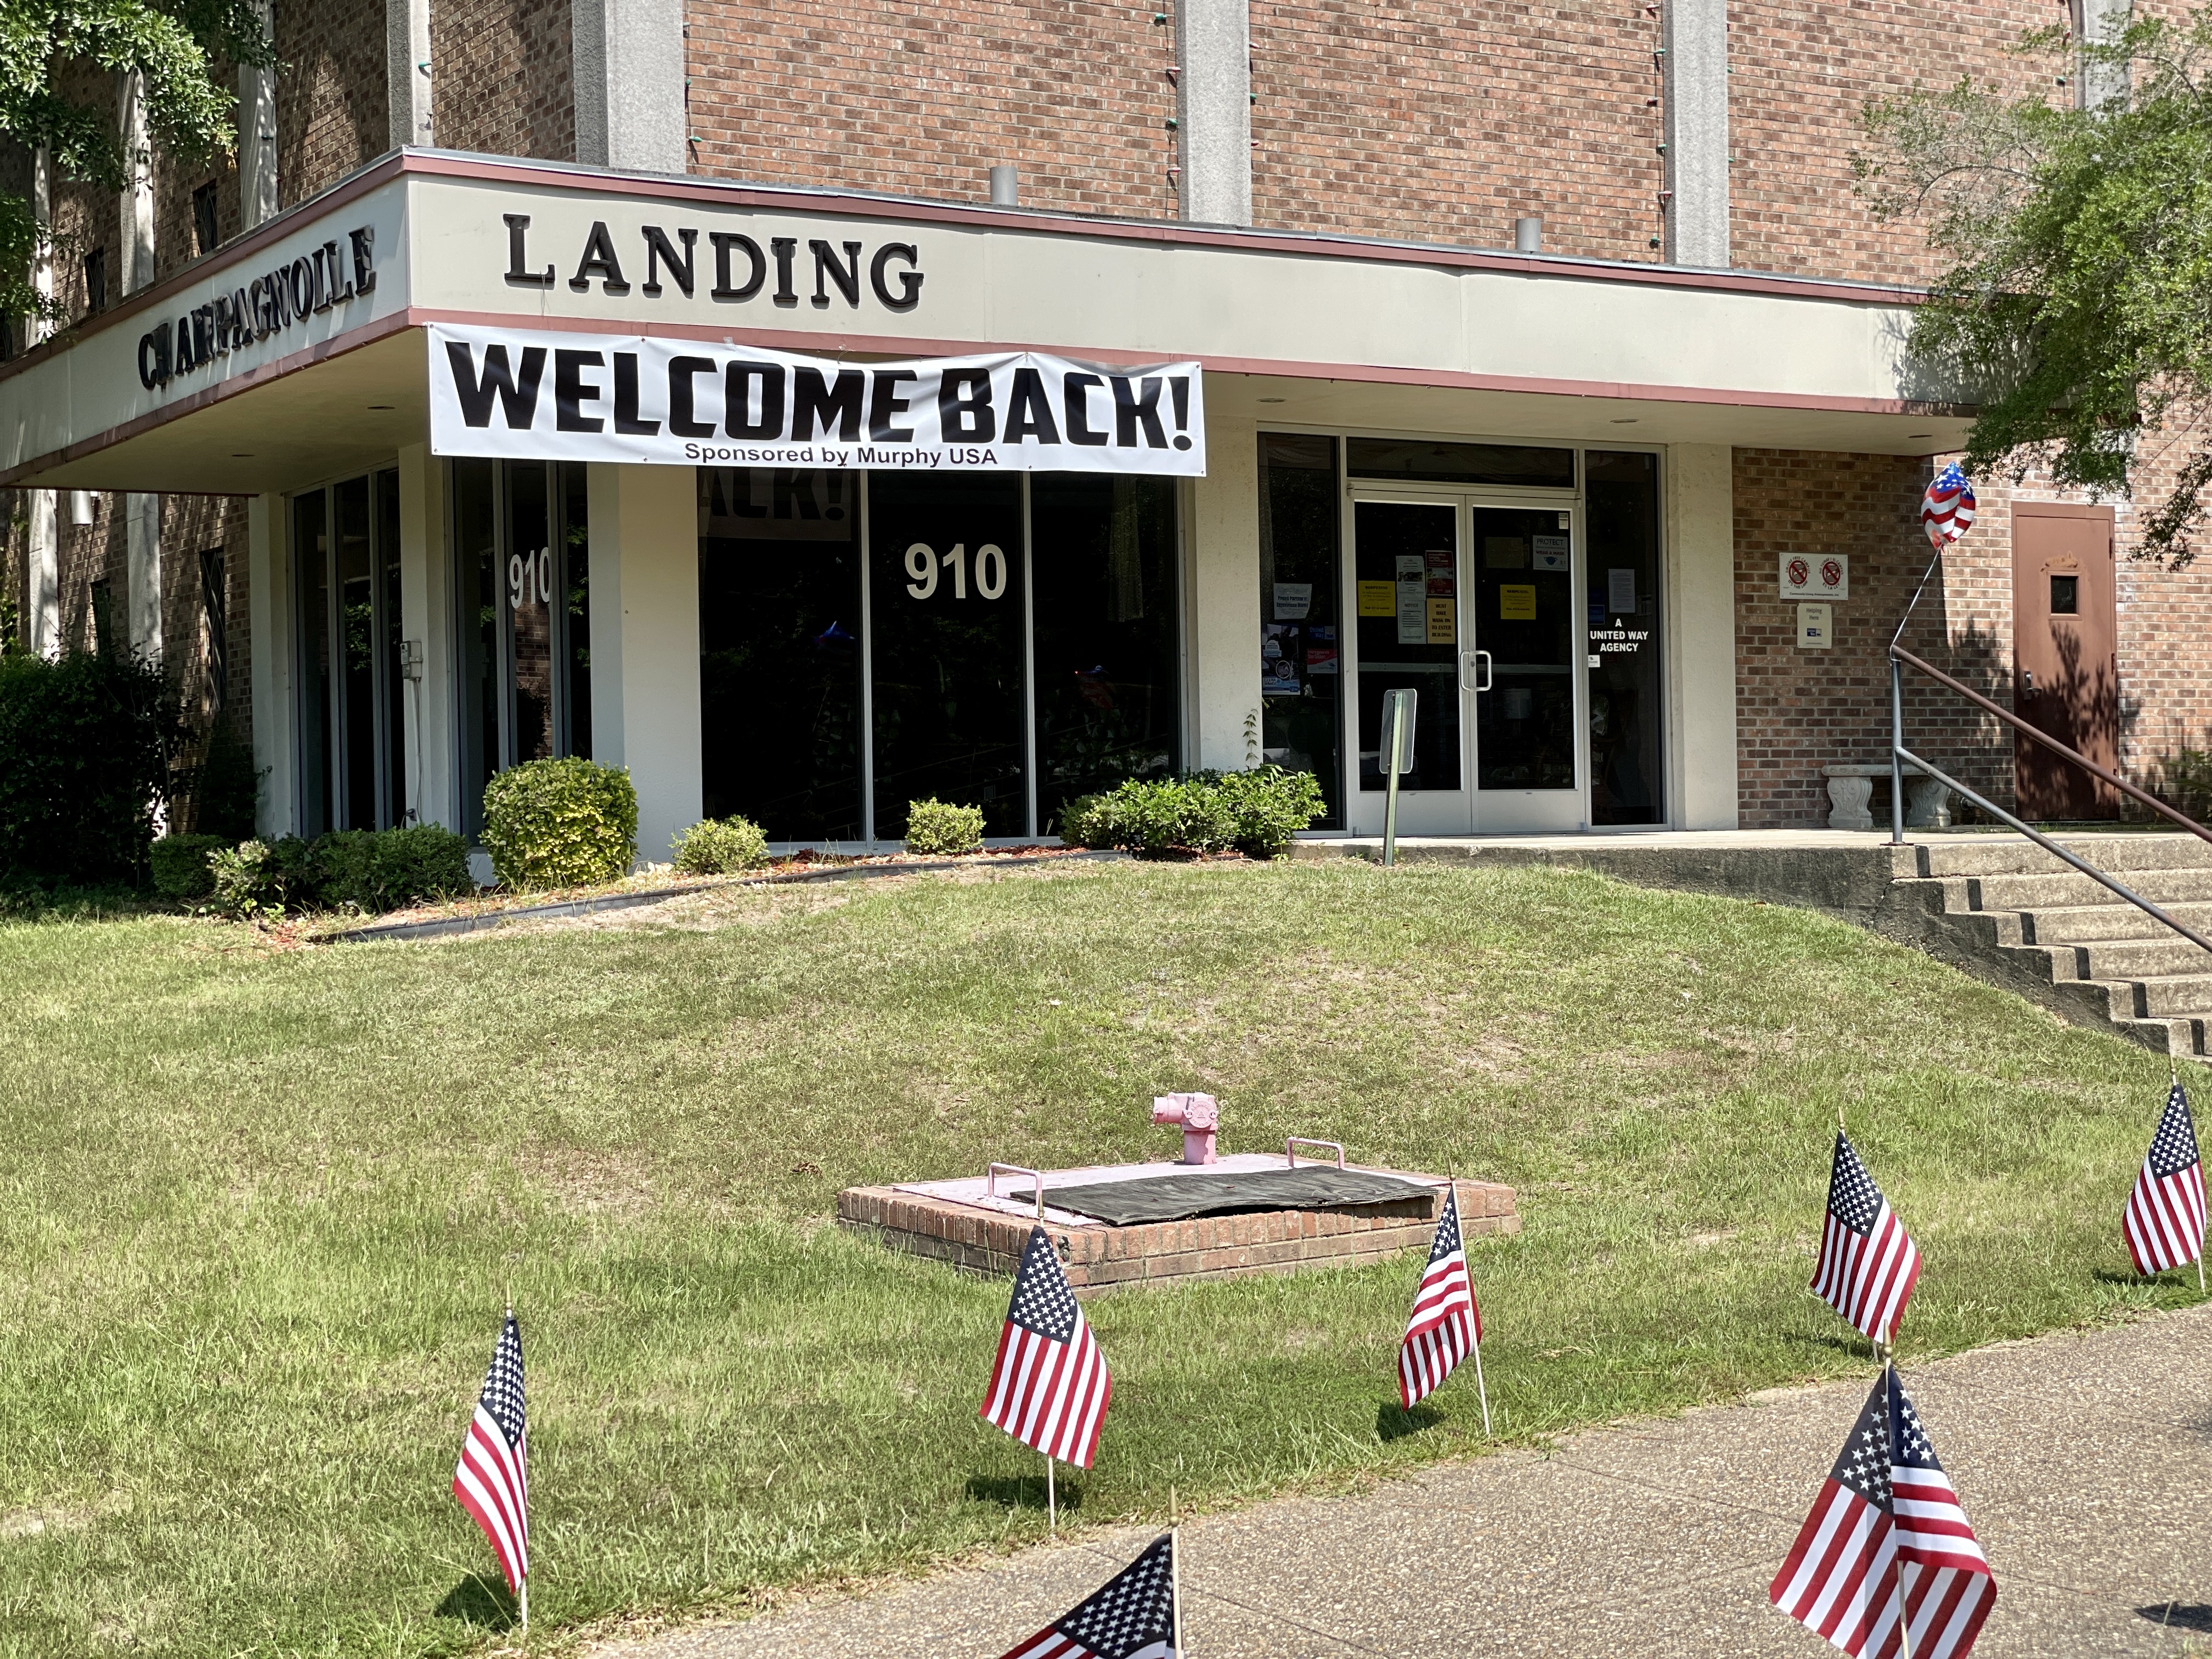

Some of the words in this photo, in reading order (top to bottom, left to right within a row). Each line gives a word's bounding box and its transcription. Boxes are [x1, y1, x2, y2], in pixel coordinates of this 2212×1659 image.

[503, 213, 924, 307] LANDING
[445, 341, 918, 443] WELCOME
[938, 368, 1192, 451] BACK!
[685, 443, 814, 464] Sponsored
[821, 447, 849, 466] by
[857, 447, 941, 468] Murphy
[950, 448, 998, 464] USA
[509, 546, 550, 609] 910
[905, 543, 1007, 600] 910
[1801, 557, 1811, 574] CAMPUS
[1590, 630, 1626, 640] UNITED
[1627, 631, 1649, 640] WAY
[1615, 618, 1622, 627] A
[1600, 642, 1639, 652] AGENCY
